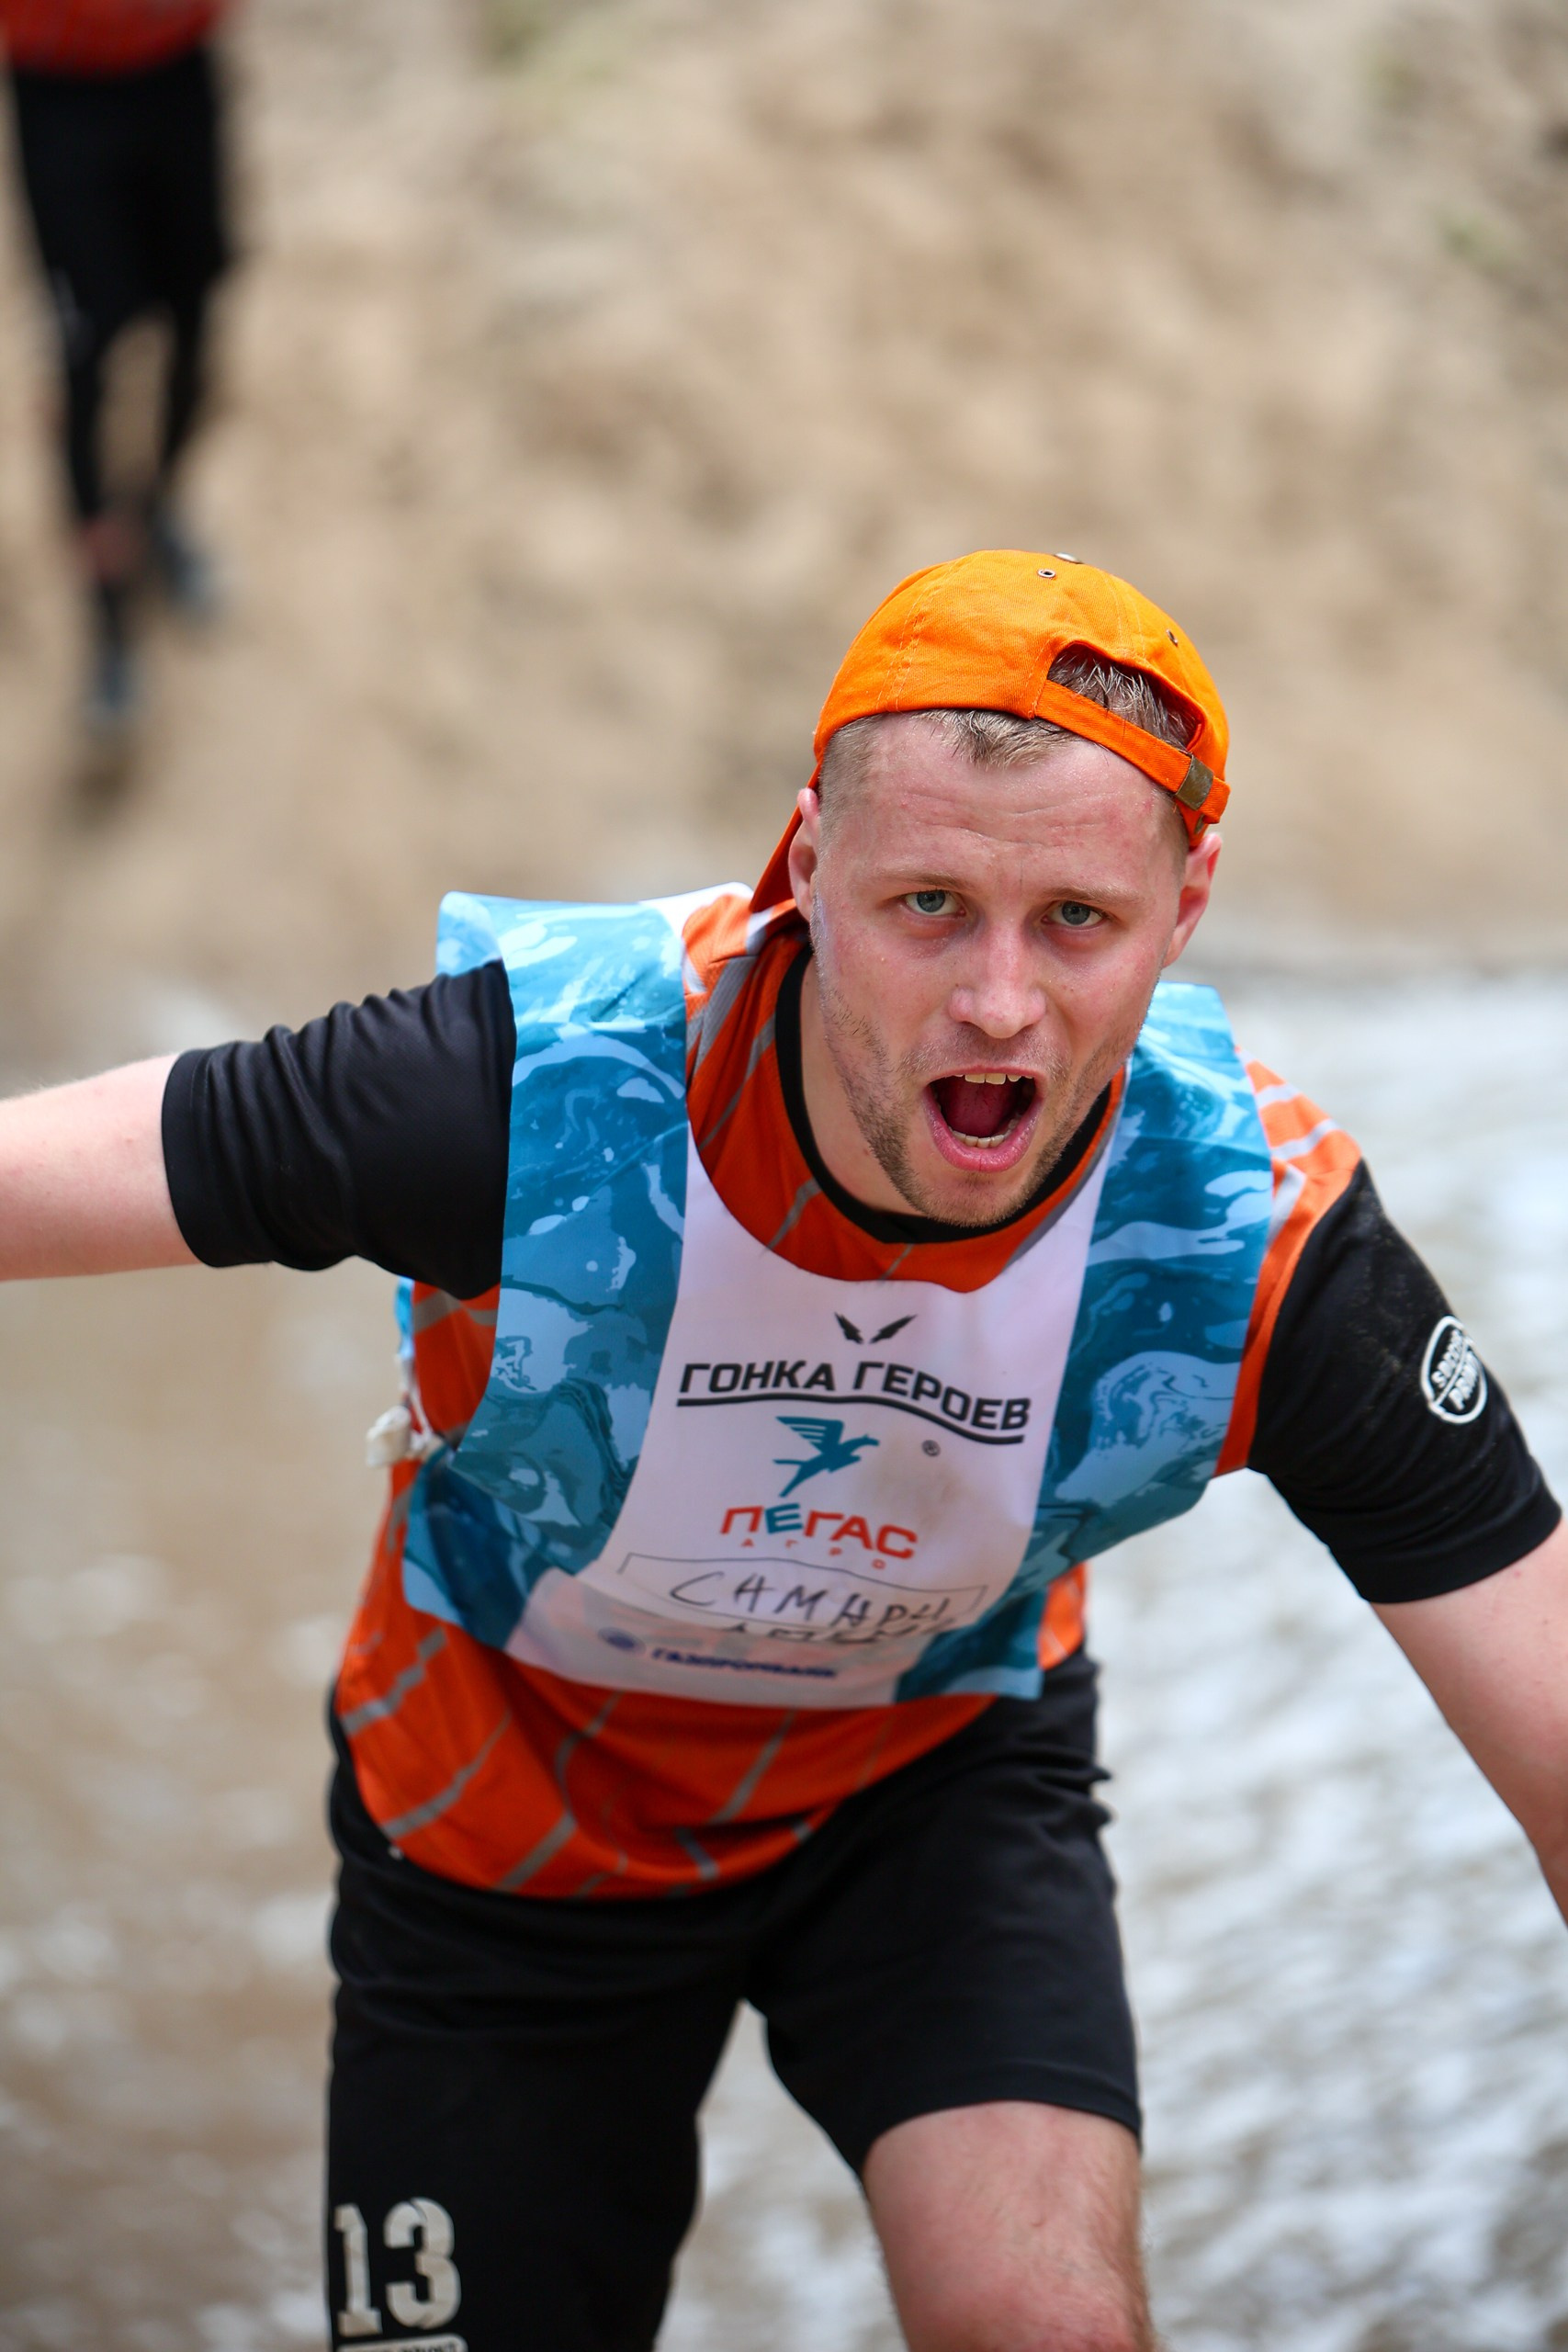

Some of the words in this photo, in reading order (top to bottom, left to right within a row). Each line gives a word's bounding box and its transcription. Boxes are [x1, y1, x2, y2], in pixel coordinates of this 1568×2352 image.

[679, 1360, 835, 1394] ГОНКА
[852, 1361, 1032, 1431] ГЕРОЕВ
[719, 1502, 919, 1560] ПЕГАС
[740, 1538, 886, 1570] АГРО
[334, 2196, 462, 2338] 13
